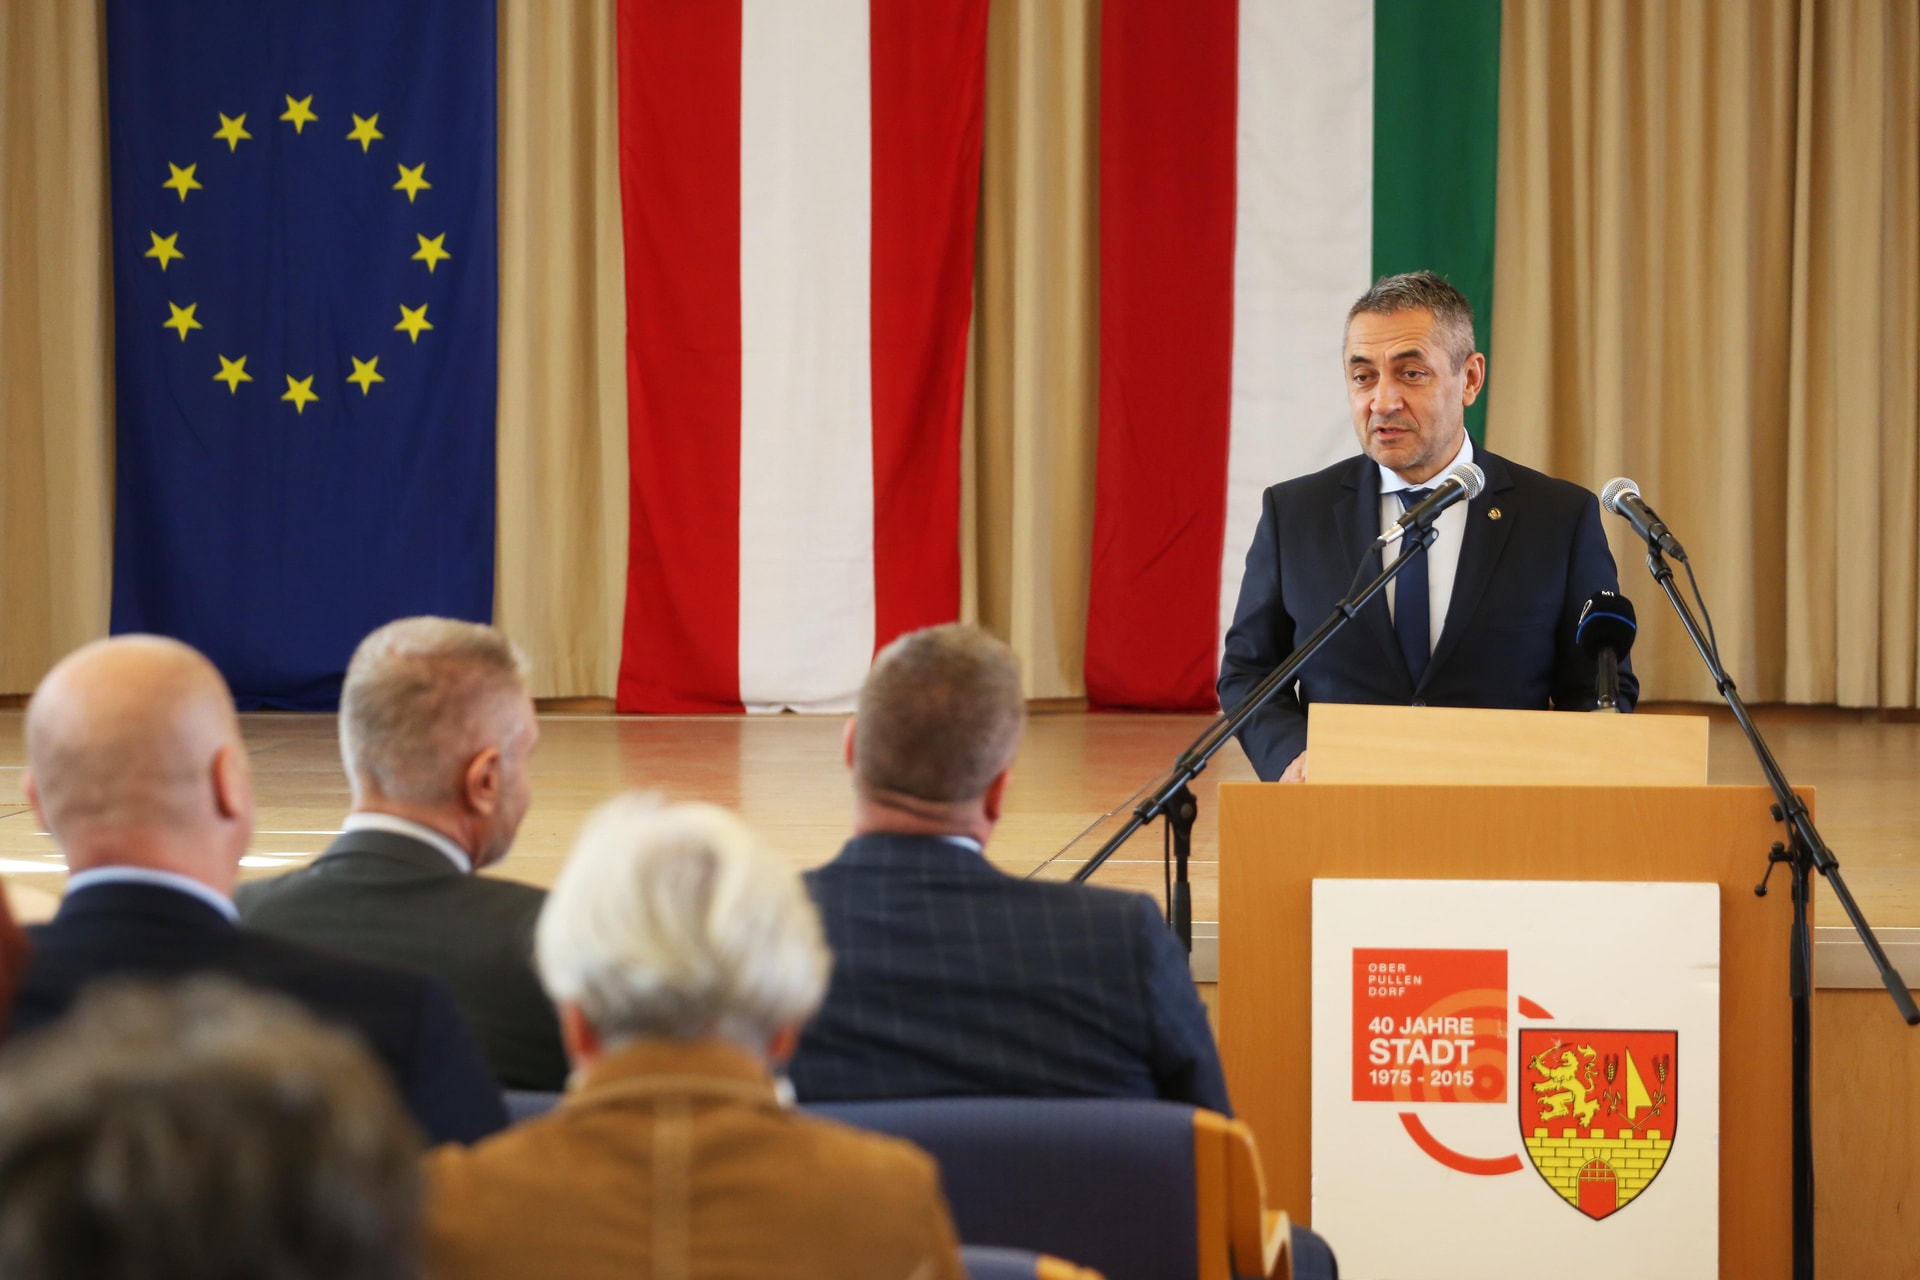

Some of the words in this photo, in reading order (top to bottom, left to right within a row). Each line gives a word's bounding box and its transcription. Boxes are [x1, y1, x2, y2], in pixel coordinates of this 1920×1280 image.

[1368, 963, 1406, 972] OBER
[1368, 975, 1422, 985] PULLEN
[1368, 986, 1405, 996] DORF
[1368, 1016, 1394, 1034] 40
[1399, 1016, 1474, 1035] JAHRE
[1368, 1037, 1475, 1066] STADT
[1369, 1069, 1412, 1086] 1975
[1430, 1070, 1474, 1086] 2015
